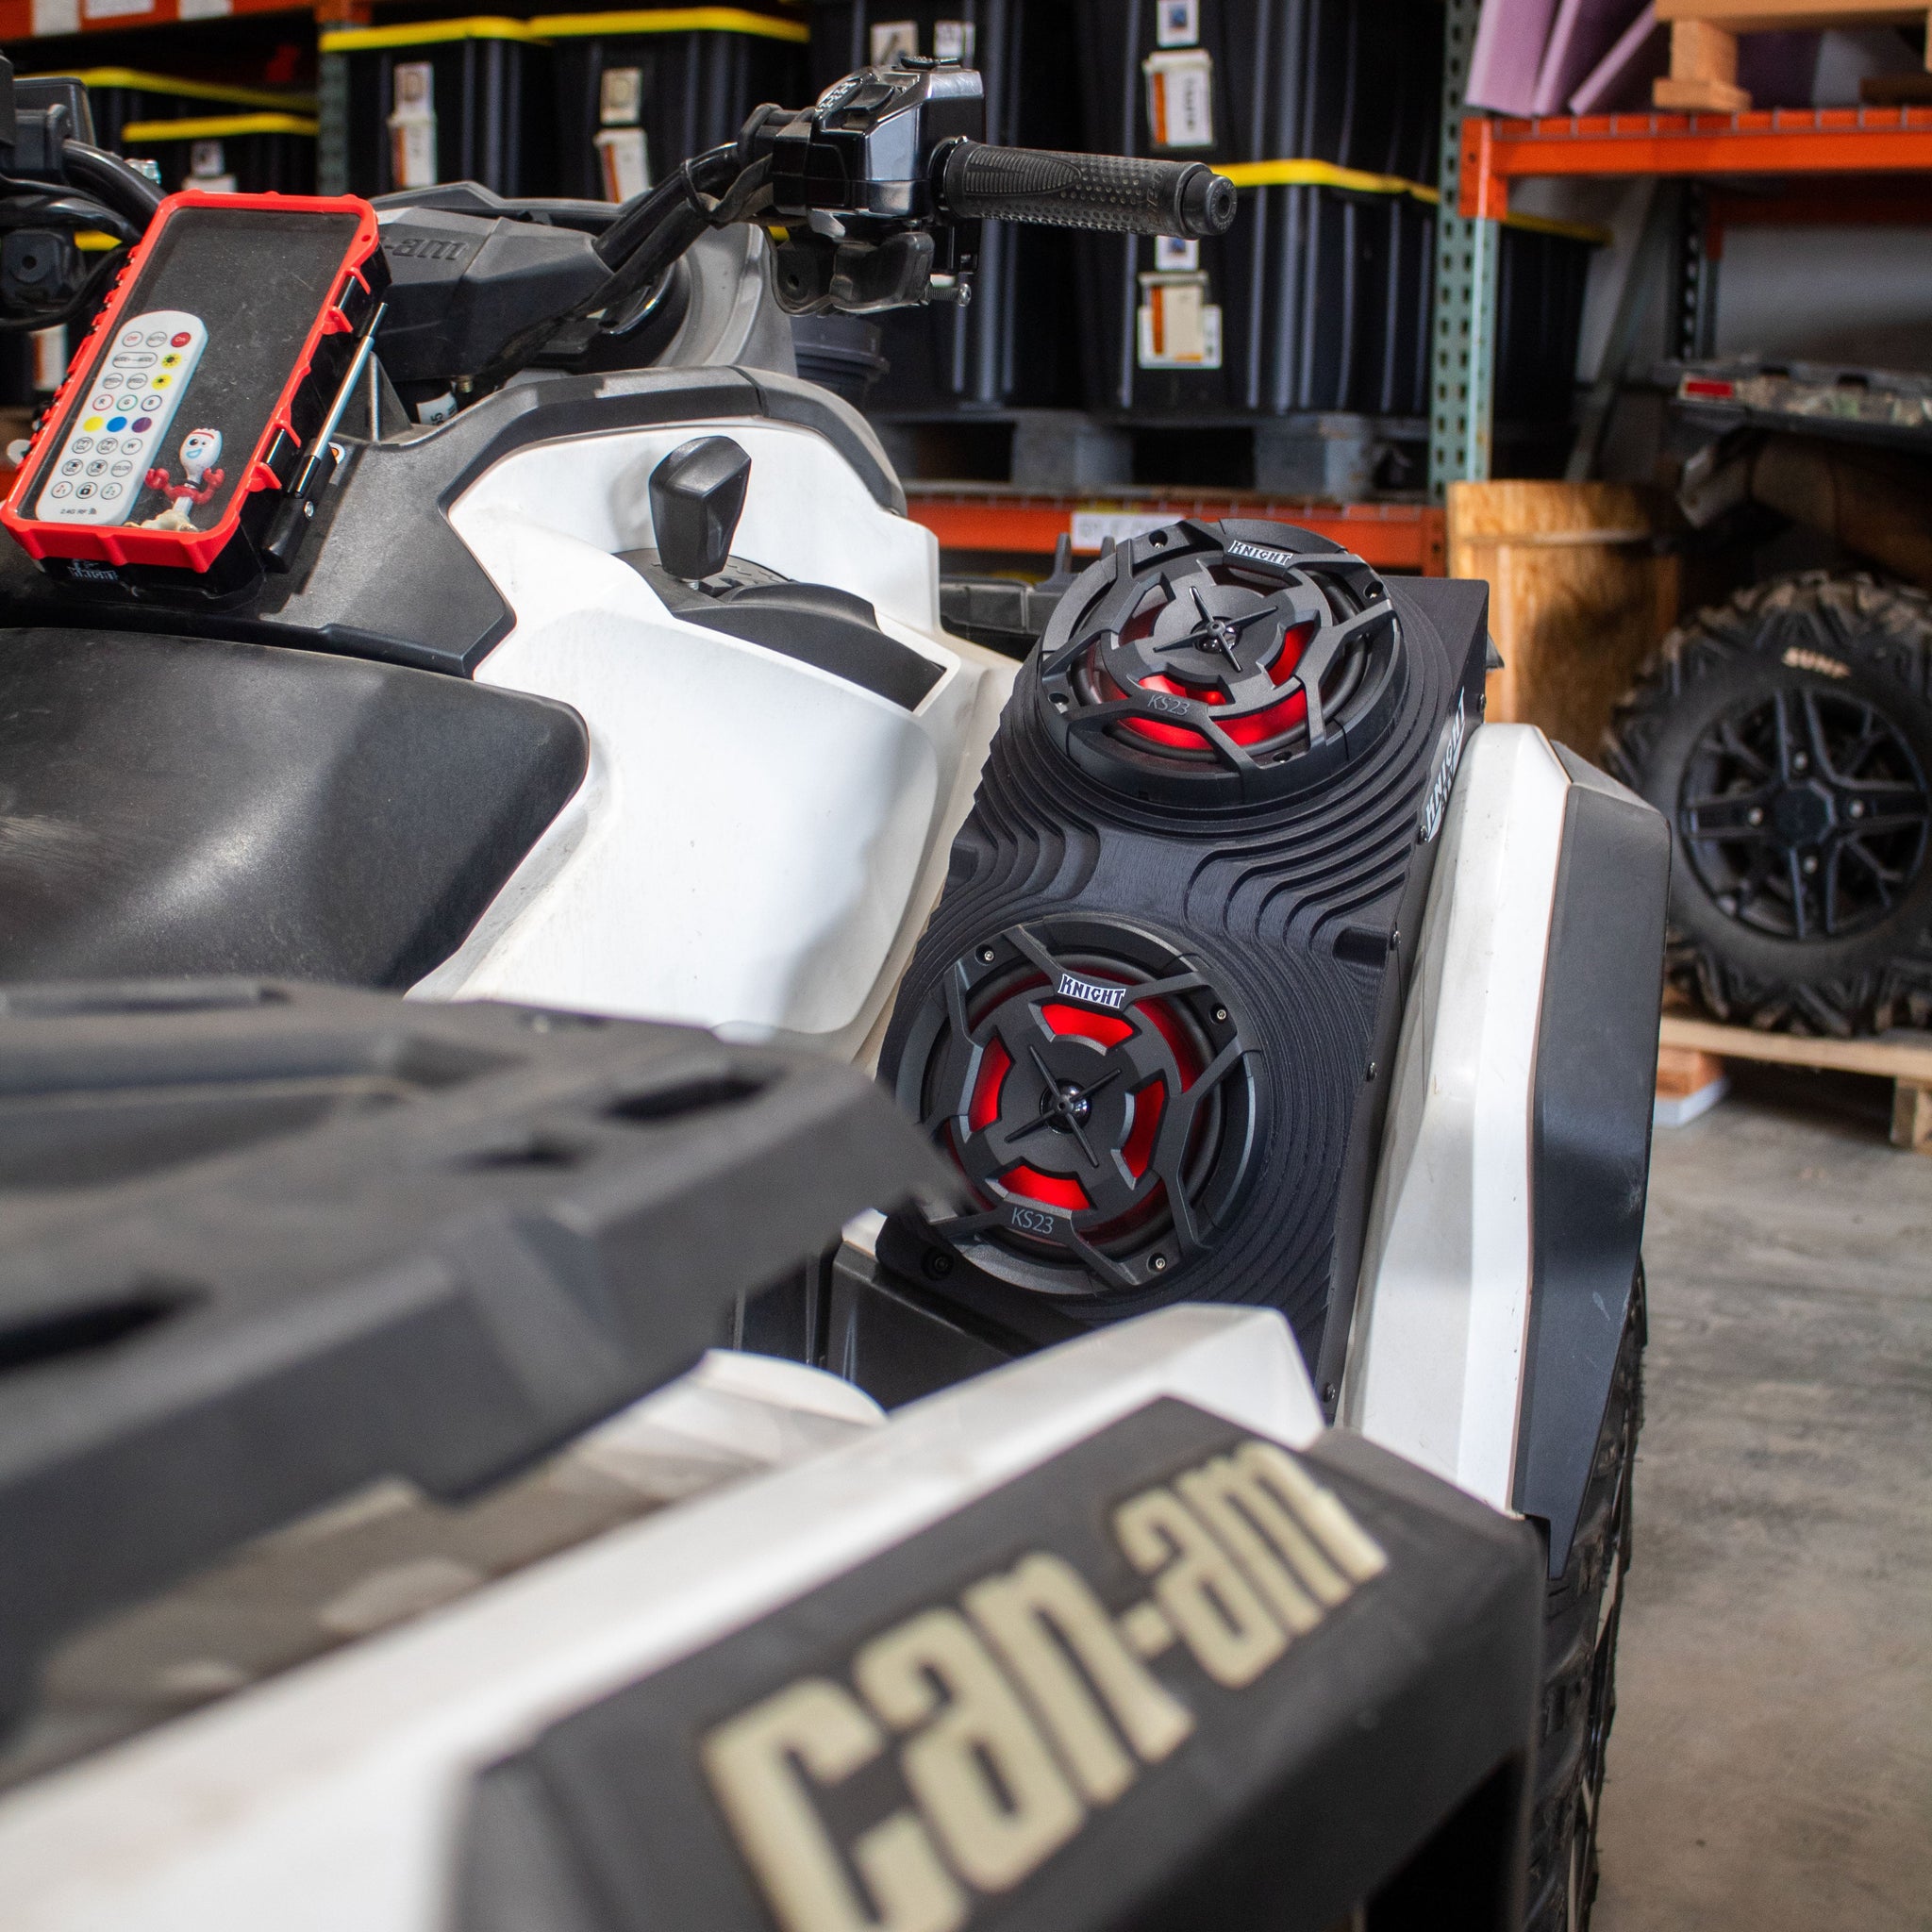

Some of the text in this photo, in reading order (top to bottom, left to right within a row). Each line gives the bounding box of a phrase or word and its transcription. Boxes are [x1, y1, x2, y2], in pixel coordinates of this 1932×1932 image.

[1228, 540, 1293, 566] KNIGHT
[1147, 694, 1191, 716] KS23
[1425, 687, 1465, 835] KNIGHT
[1058, 974, 1125, 1008] KNIGHT
[1011, 1207, 1054, 1235] KS23
